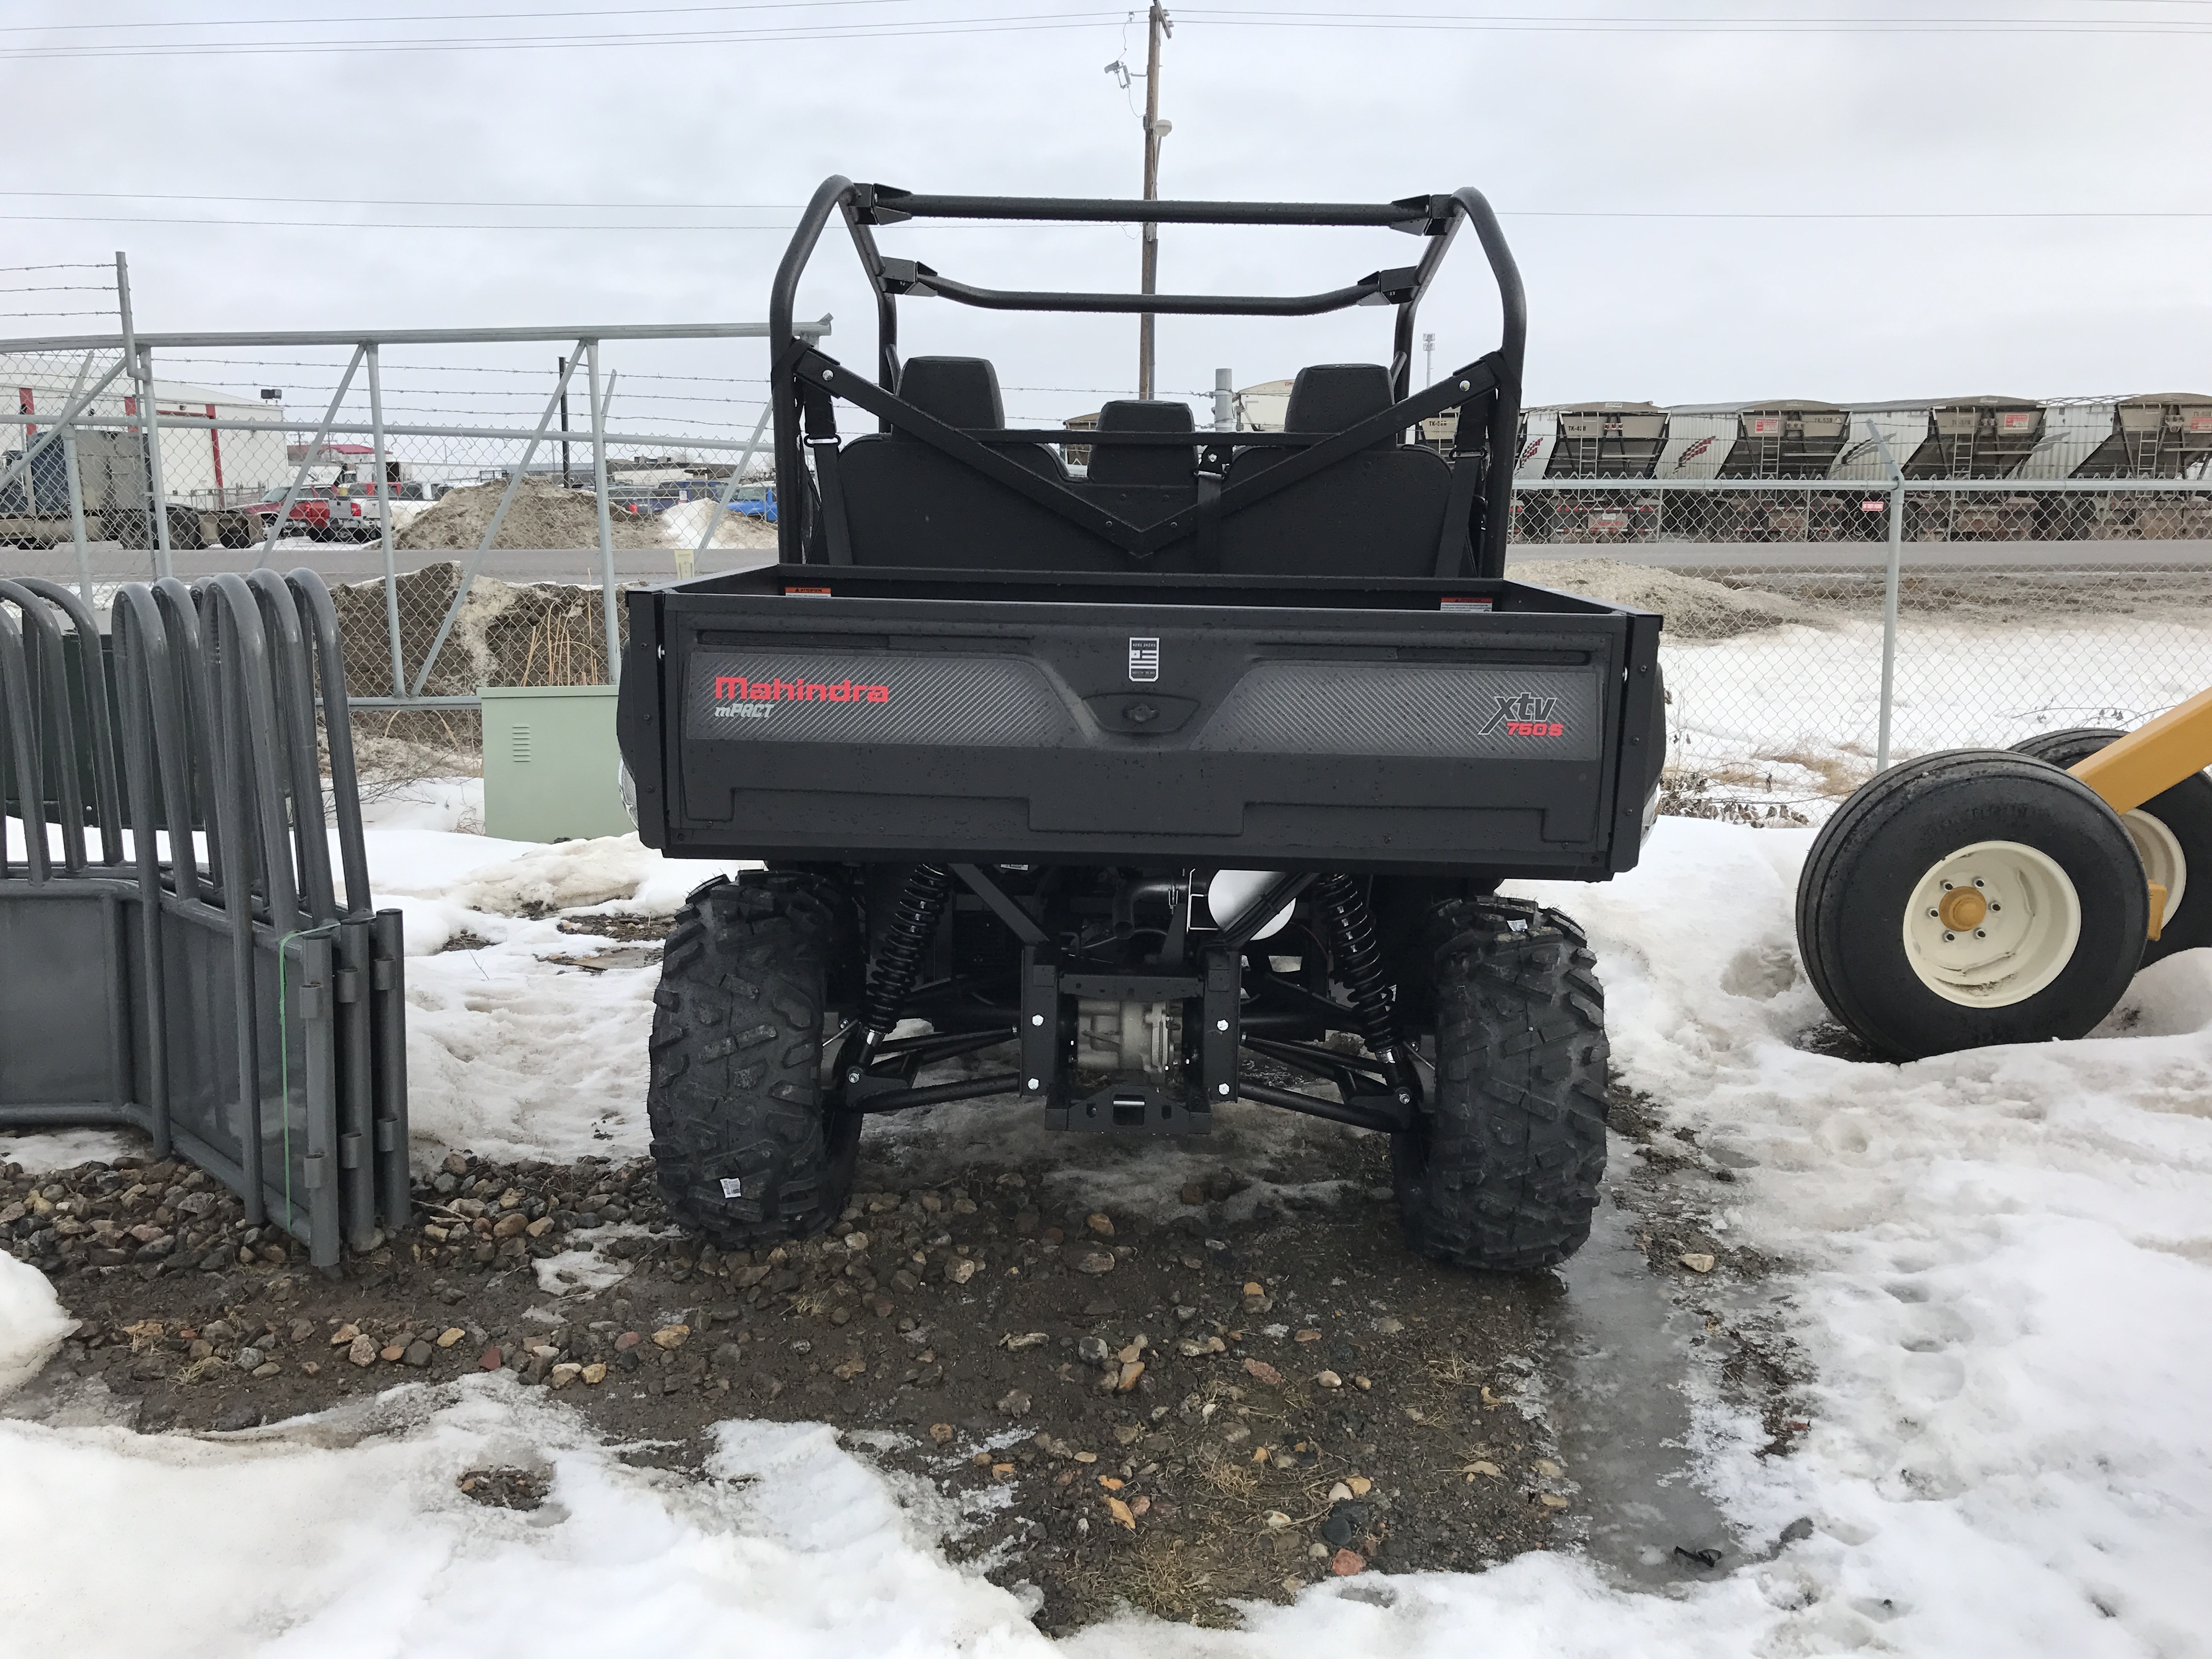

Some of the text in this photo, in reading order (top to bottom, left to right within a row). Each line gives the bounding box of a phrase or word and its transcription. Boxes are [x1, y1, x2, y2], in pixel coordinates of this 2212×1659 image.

[715, 676, 889, 703] Mahindra
[714, 703, 775, 718] mPACT
[1506, 721, 1564, 737] 750S
